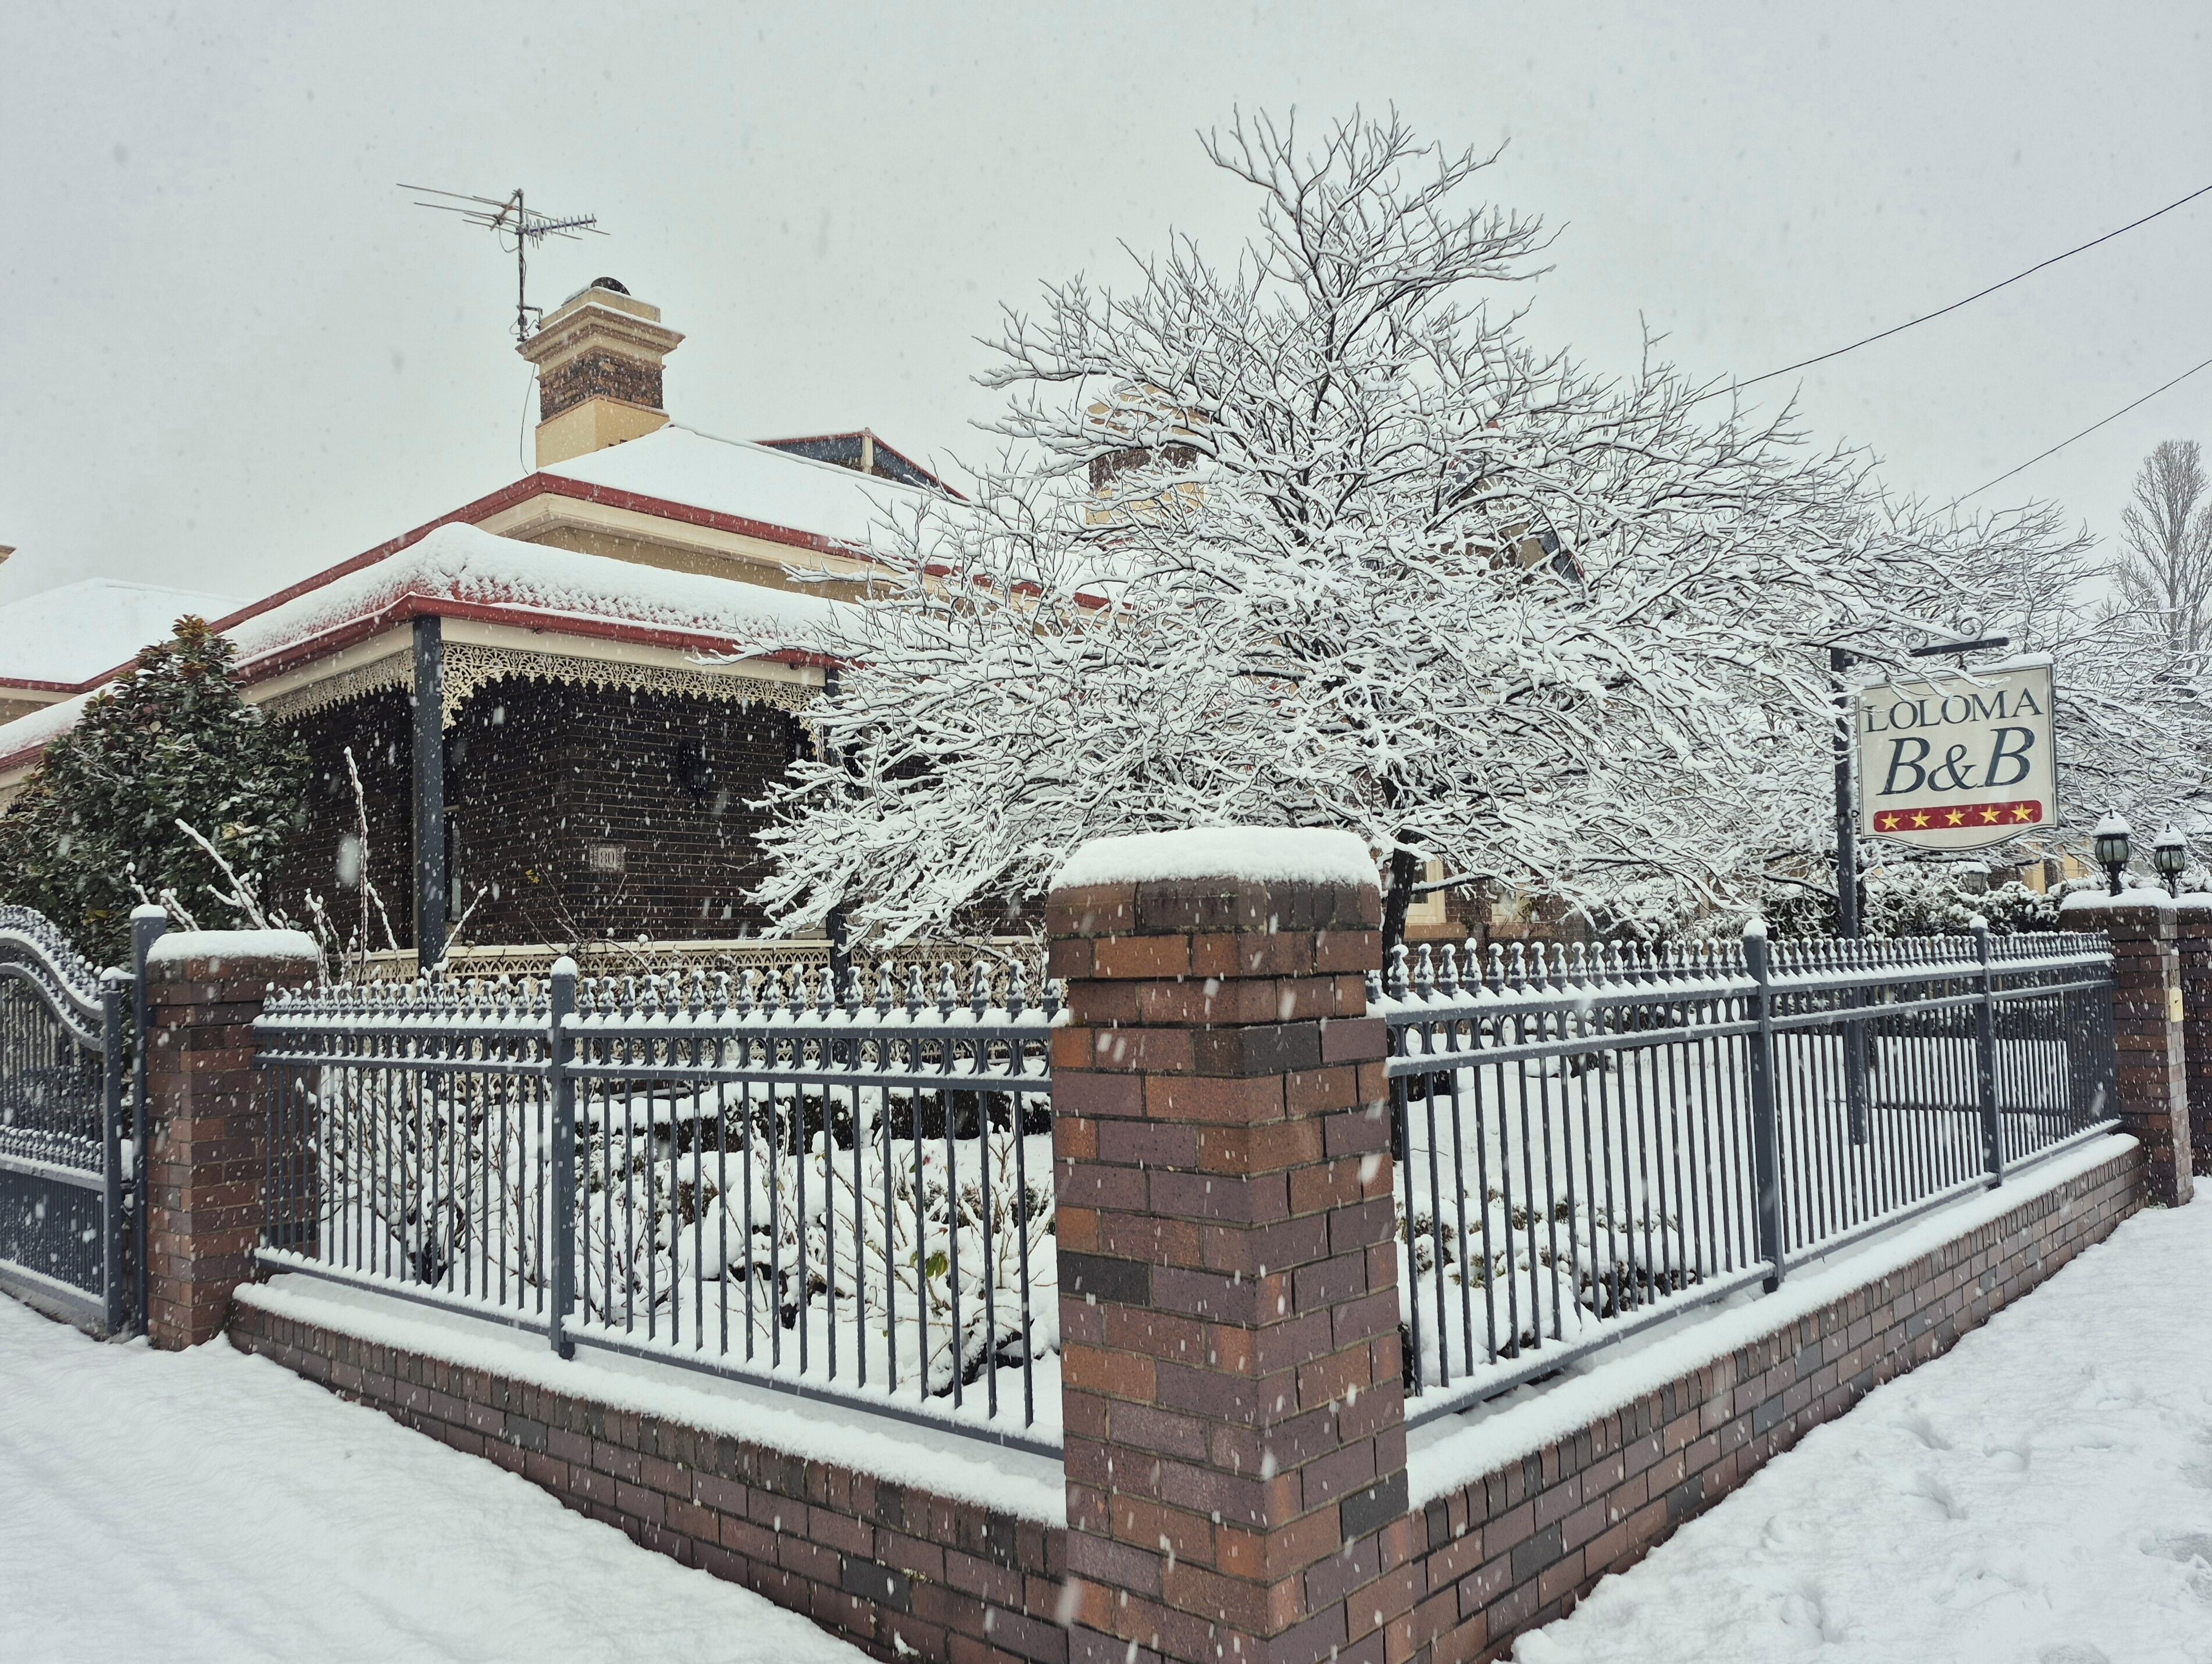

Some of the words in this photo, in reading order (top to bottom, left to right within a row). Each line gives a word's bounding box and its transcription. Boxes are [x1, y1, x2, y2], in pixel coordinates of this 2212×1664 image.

[1864, 687, 2044, 733] LOLOMA
[1876, 727, 2035, 796] B&B
[601, 851, 614, 865] 80
